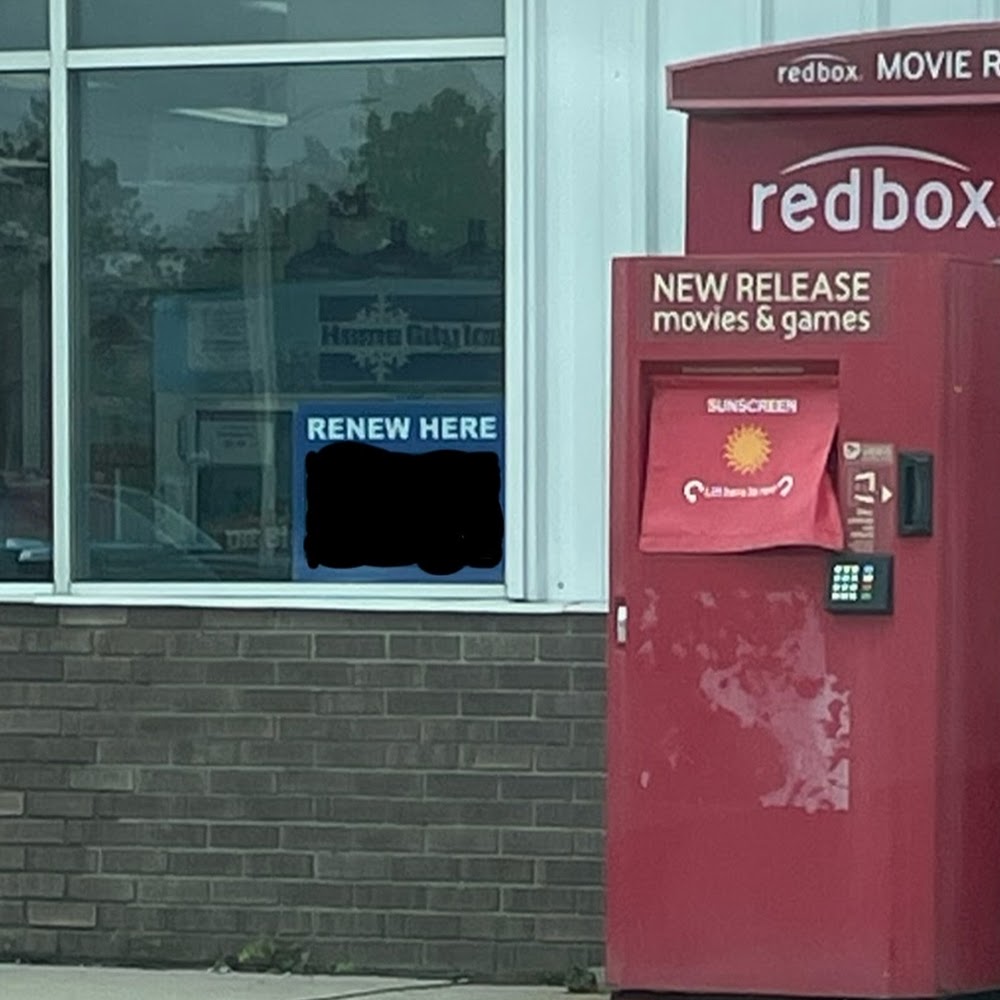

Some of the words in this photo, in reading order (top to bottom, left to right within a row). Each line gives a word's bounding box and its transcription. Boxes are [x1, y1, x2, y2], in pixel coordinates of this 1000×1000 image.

[777, 61, 860, 84] redbox
[876, 50, 972, 80] MOVIE
[751, 167, 998, 232] redbox
[653, 272, 729, 302] NEW
[736, 271, 871, 302] RELEASE
[653, 304, 749, 332] movies
[755, 304, 776, 332] &
[781, 309, 871, 341] games
[707, 398, 798, 414] SUNSCREEN
[307, 416, 411, 441] RENEW
[419, 416, 498, 440] HERE
